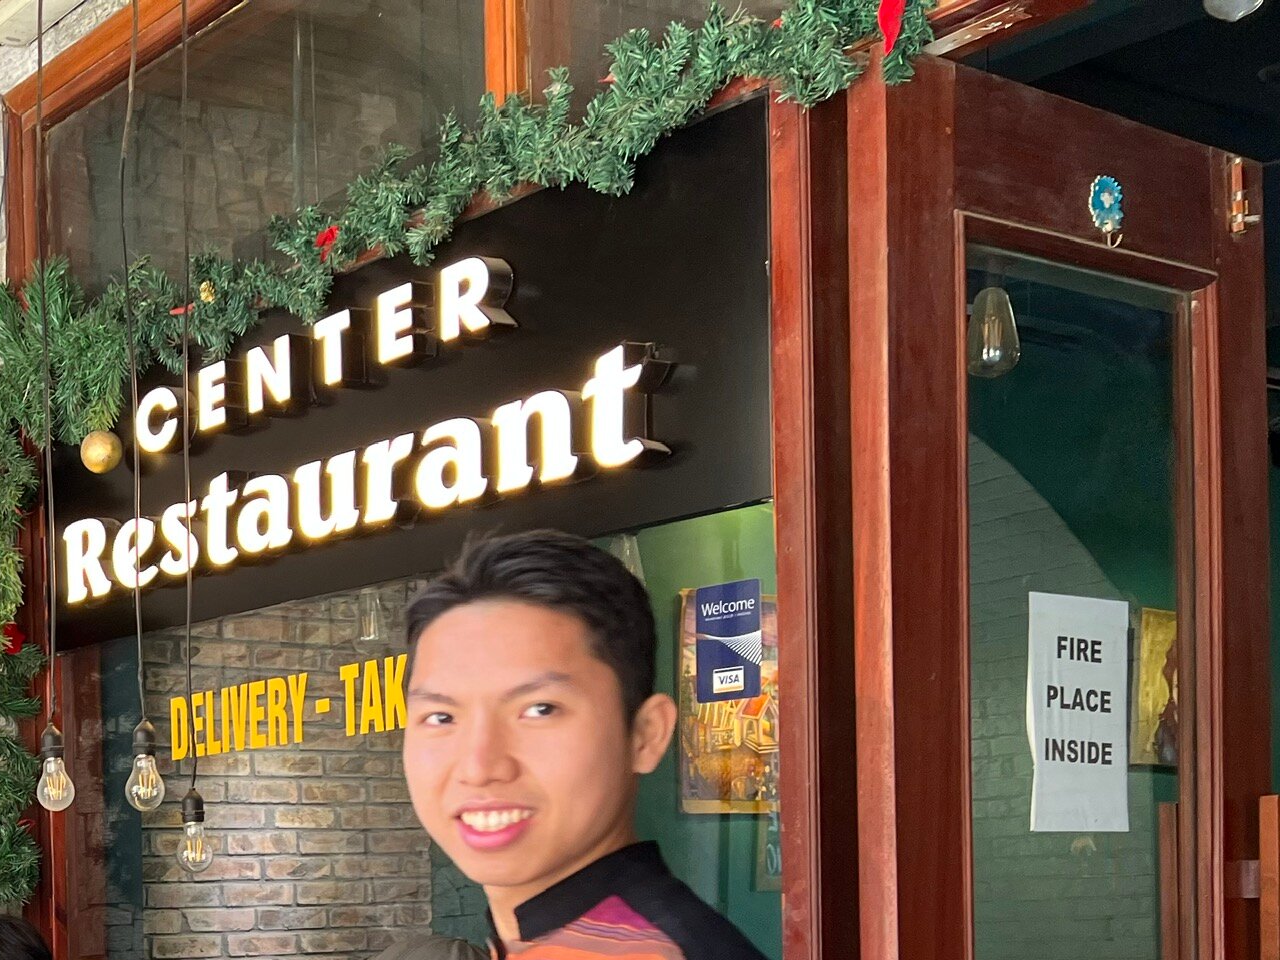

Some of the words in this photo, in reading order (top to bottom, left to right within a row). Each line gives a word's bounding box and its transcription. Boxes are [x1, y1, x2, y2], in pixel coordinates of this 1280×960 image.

[133, 256, 494, 454] CENTER
[61, 343, 645, 604] Restaurant
[701, 598, 755, 617] Welcome
[1056, 635, 1103, 664] FIRE
[718, 674, 740, 685] VISA
[170, 672, 308, 761] DELIVERY
[339, 653, 408, 737] TAK
[1046, 684, 1112, 714] PLACE
[1044, 737, 1113, 766] INSIDE
